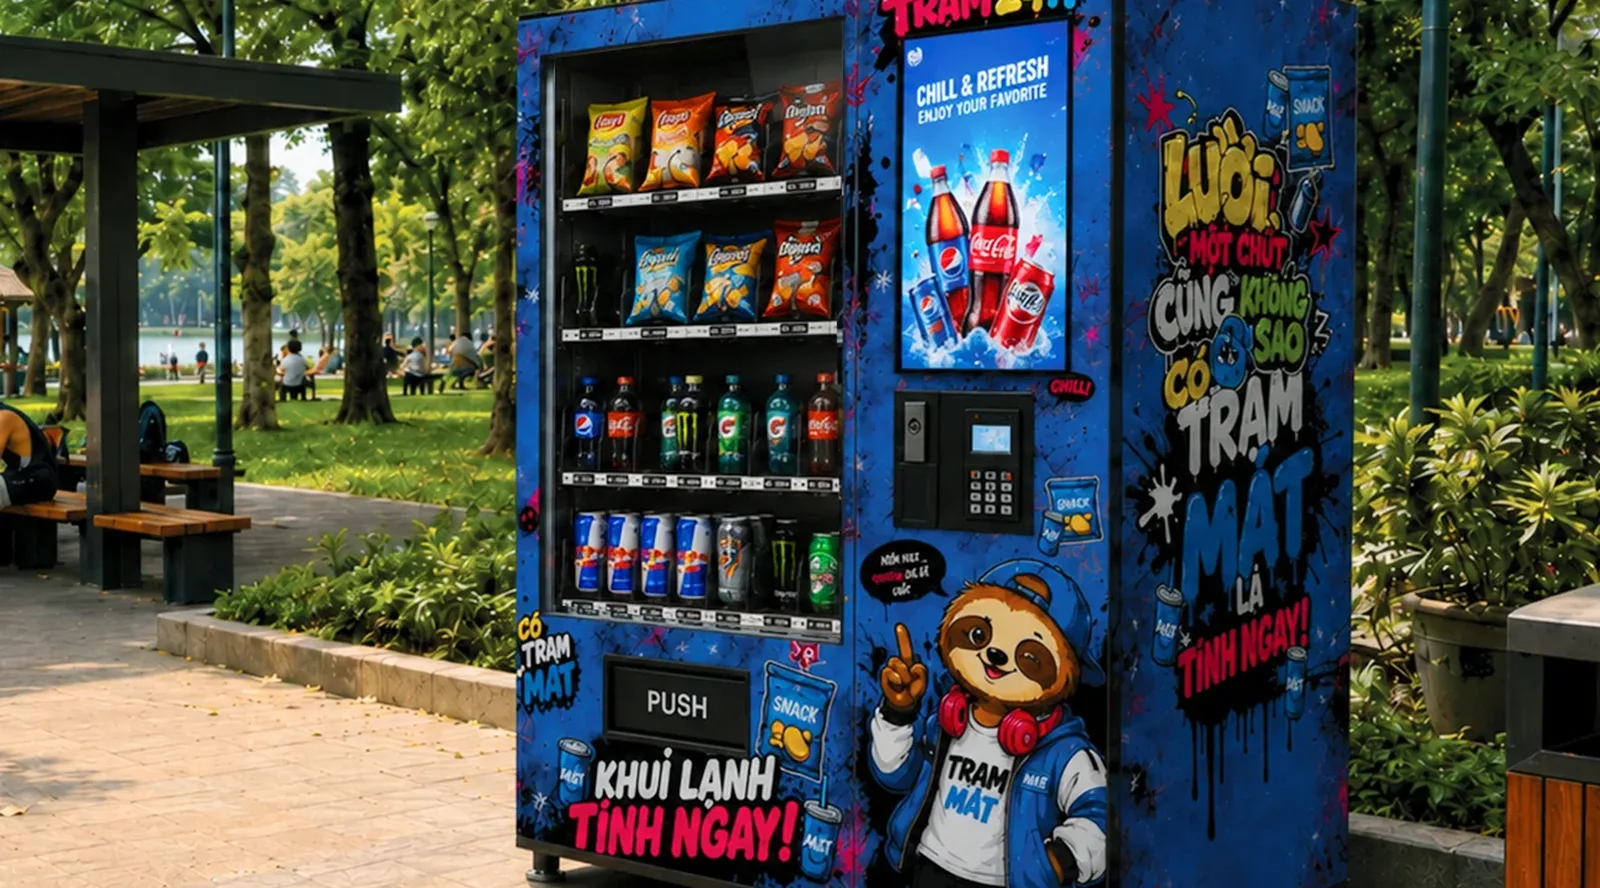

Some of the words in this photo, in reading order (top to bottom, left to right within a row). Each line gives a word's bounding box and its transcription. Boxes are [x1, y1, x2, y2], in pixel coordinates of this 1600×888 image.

[916, 78, 958, 107] CHILL
[960, 74, 973, 97] &
[976, 55, 1049, 94] REFRESH
[917, 104, 954, 125] ENJOY
[956, 96, 988, 117] YOUR
[989, 82, 1048, 109] FAVORITE
[1253, 316, 1305, 364] SAO
[1164, 344, 1211, 410] CÓ
[1239, 595, 1310, 673] NGAY!
[647, 689, 708, 719] PUSH
[772, 695, 819, 724] SNACK
[678, 754, 777, 810] LẠNH
[670, 800, 800, 863] NGAY!
